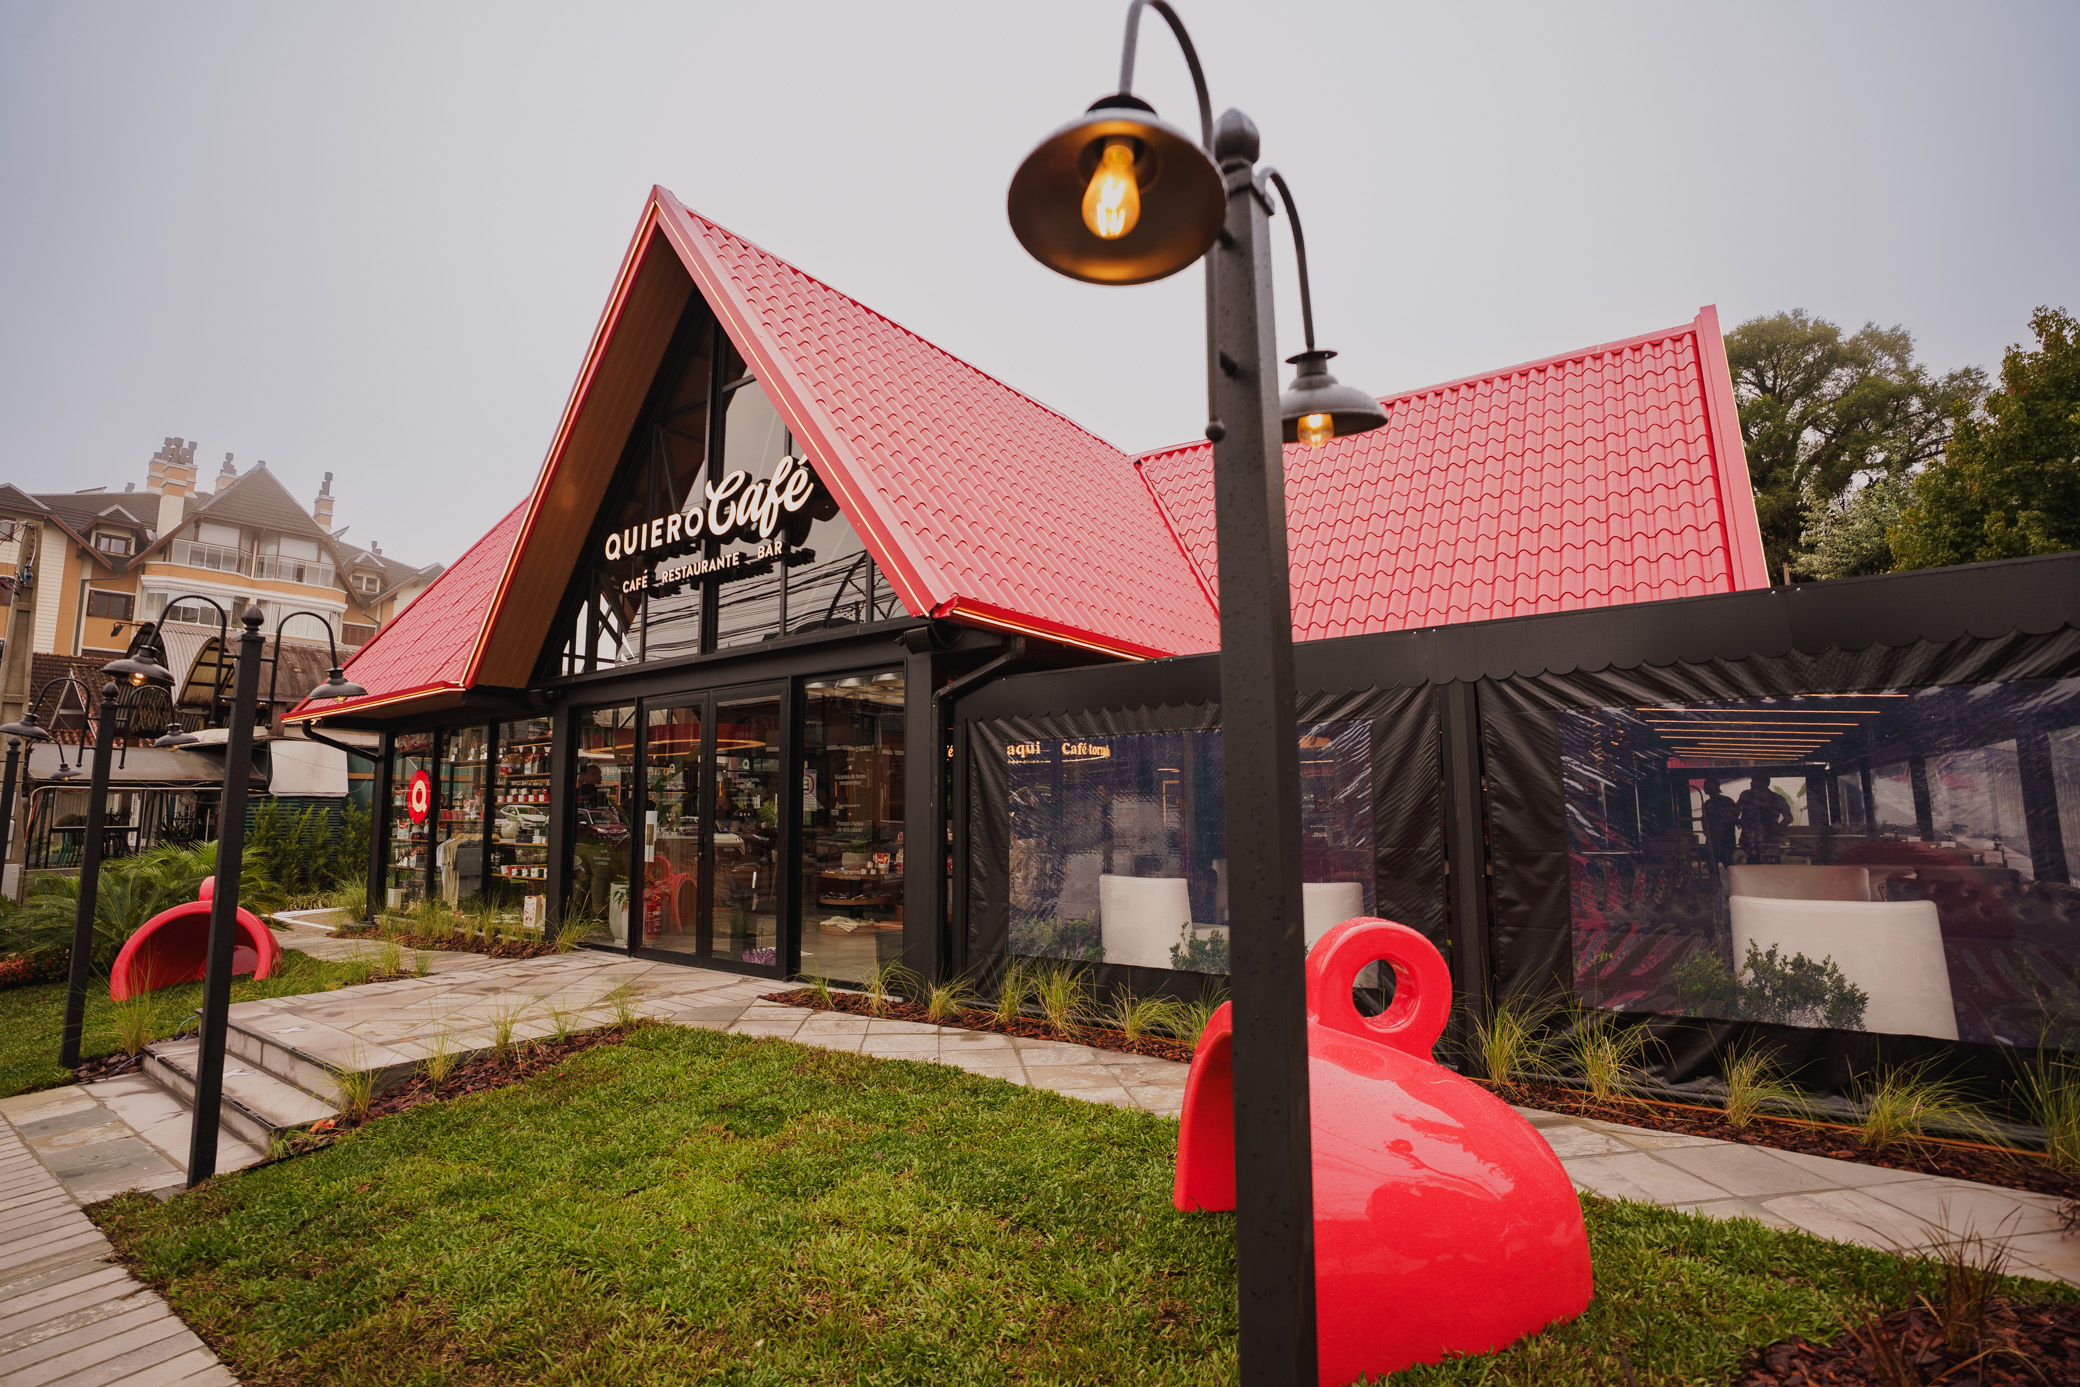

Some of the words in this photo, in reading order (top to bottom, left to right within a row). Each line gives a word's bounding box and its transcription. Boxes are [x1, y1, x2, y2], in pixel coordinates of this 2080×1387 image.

[604, 506, 704, 561] QUIERO
[704, 454, 815, 539] Café
[622, 569, 649, 594] CAFÉ
[661, 551, 740, 584] RESTAURANTE
[757, 540, 783, 560] BAR
[1006, 741, 1041, 758] aqui
[1061, 741, 1088, 756] Café
[411, 779, 427, 813] Q
